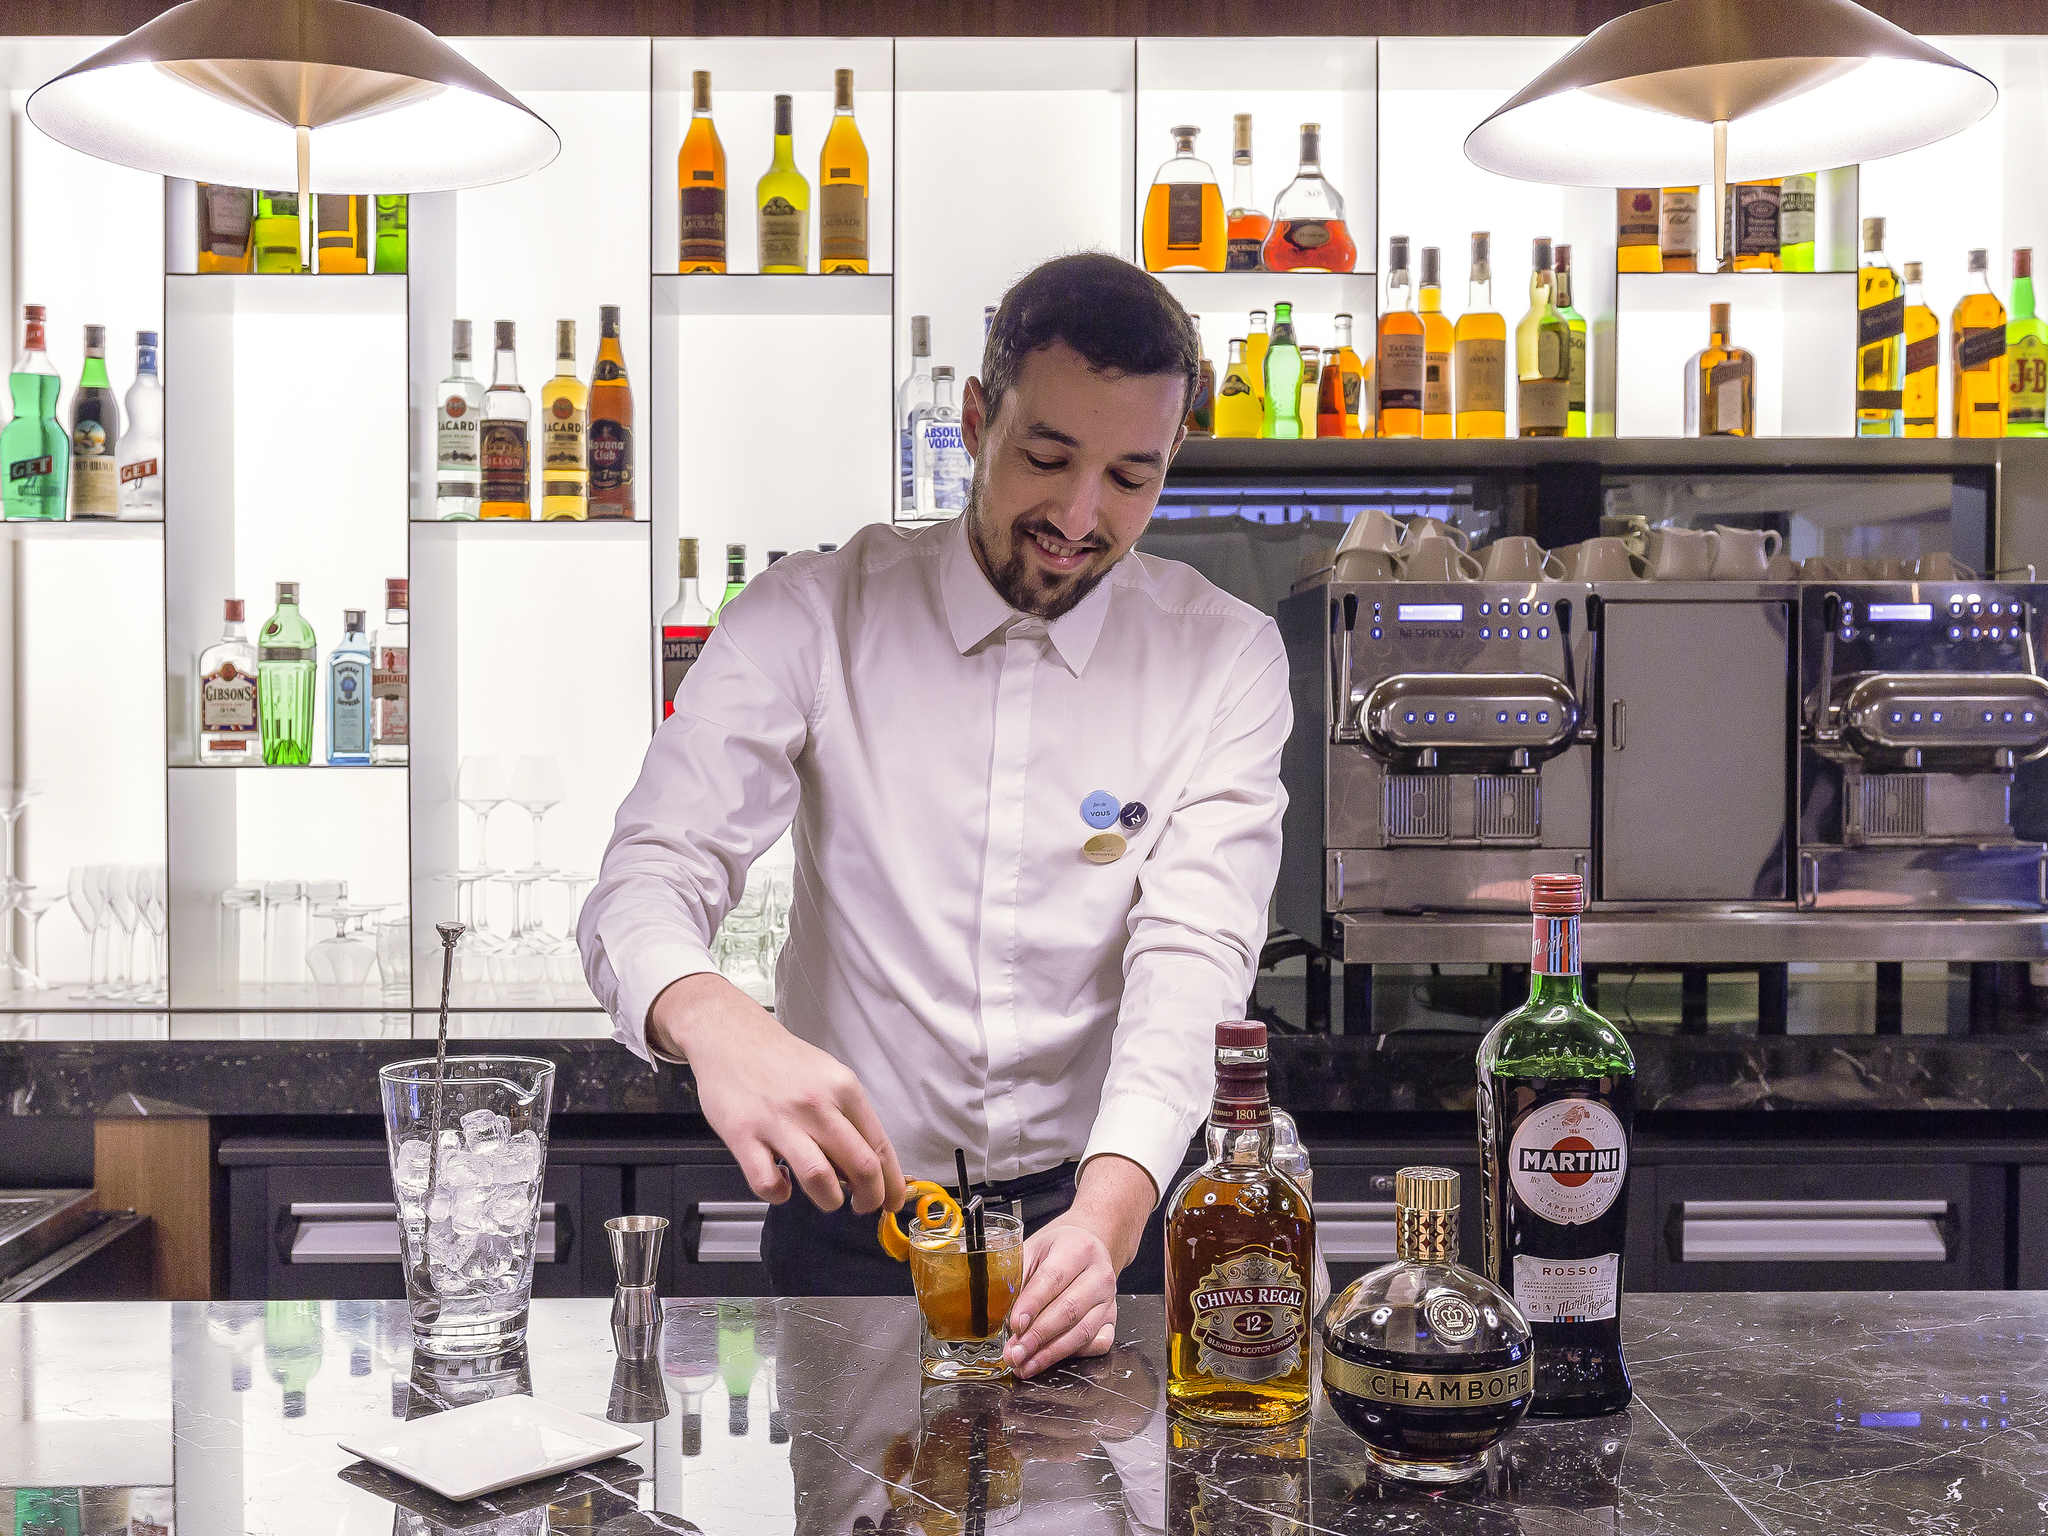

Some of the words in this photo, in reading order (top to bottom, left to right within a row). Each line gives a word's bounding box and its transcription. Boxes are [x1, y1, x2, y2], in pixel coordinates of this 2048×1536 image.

[438, 421, 478, 431] ACARDI
[544, 422, 585, 432] ACARDI
[925, 427, 961, 439] ABSOLU
[929, 438, 964, 449] VODKA
[664, 643, 703, 658] AMPA
[1236, 1109, 1256, 1120] 1801
[1523, 1150, 1617, 1171] MARTINI
[1542, 1266, 1598, 1276] ROSSO
[1196, 1289, 1253, 1309] CHIVAS
[1258, 1288, 1302, 1306] REGAL
[1246, 1315, 1261, 1332] 12
[1207, 1337, 1241, 1353] BLENDED
[1242, 1345, 1272, 1354] SCOTCH
[1371, 1369, 1529, 1401] CHAMBORD
